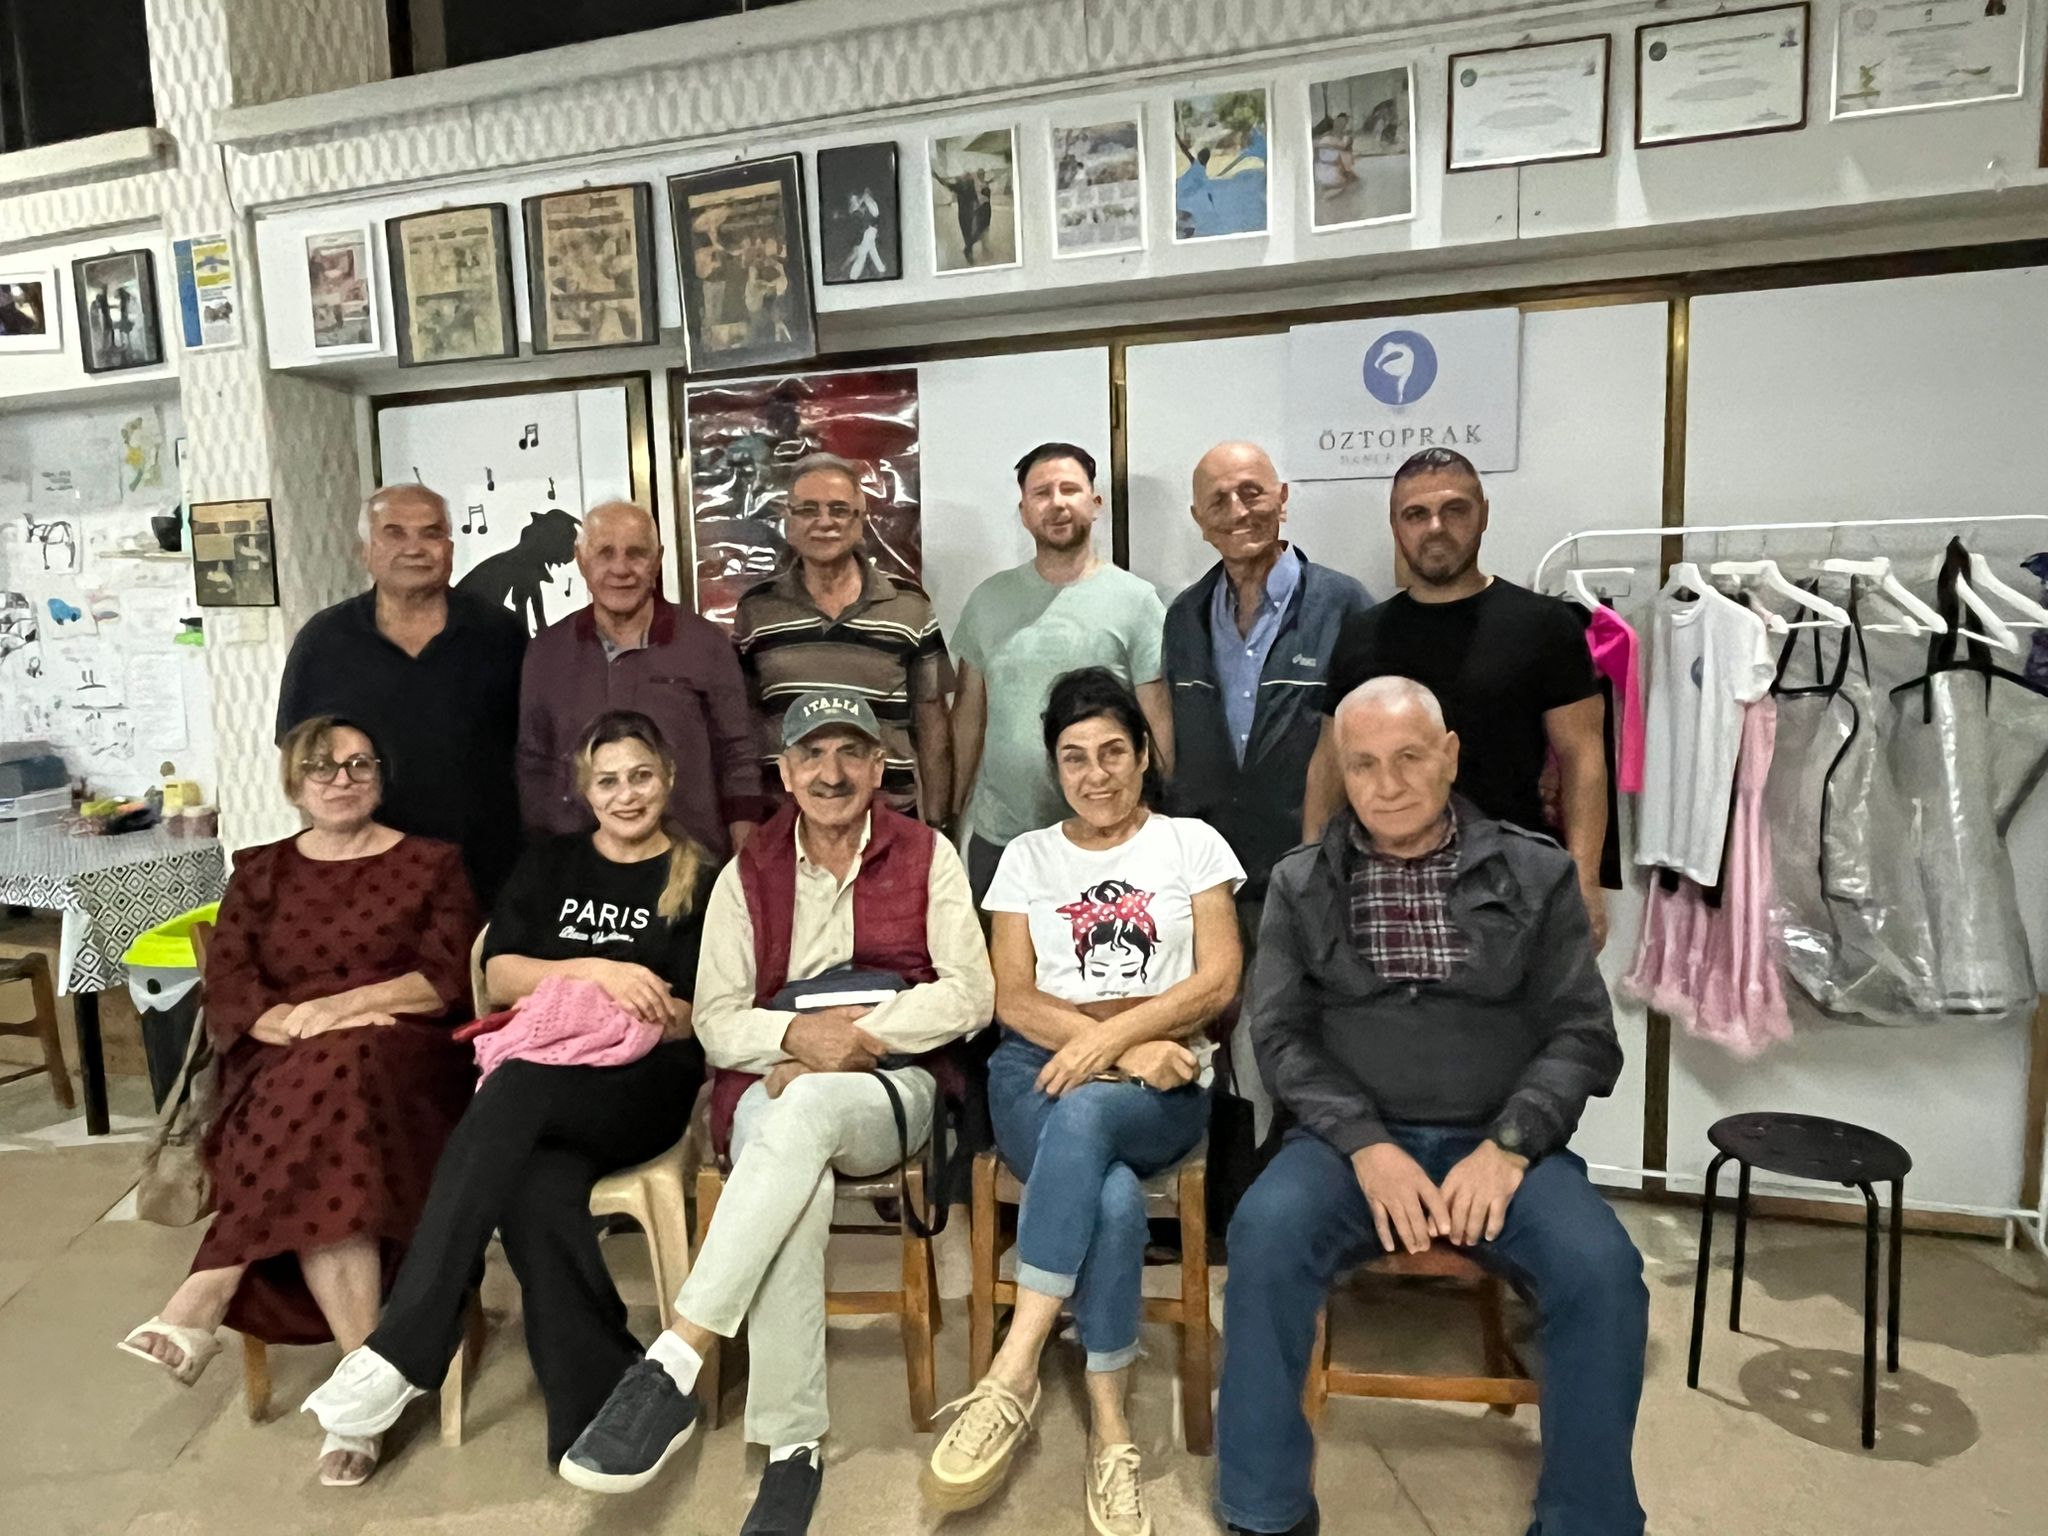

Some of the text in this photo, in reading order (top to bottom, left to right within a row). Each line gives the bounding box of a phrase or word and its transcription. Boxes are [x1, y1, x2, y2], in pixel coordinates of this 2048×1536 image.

[1319, 424, 1482, 450] ÖZTOPRAK
[803, 697, 859, 717] ITALIA
[559, 898, 650, 929] PARIS
